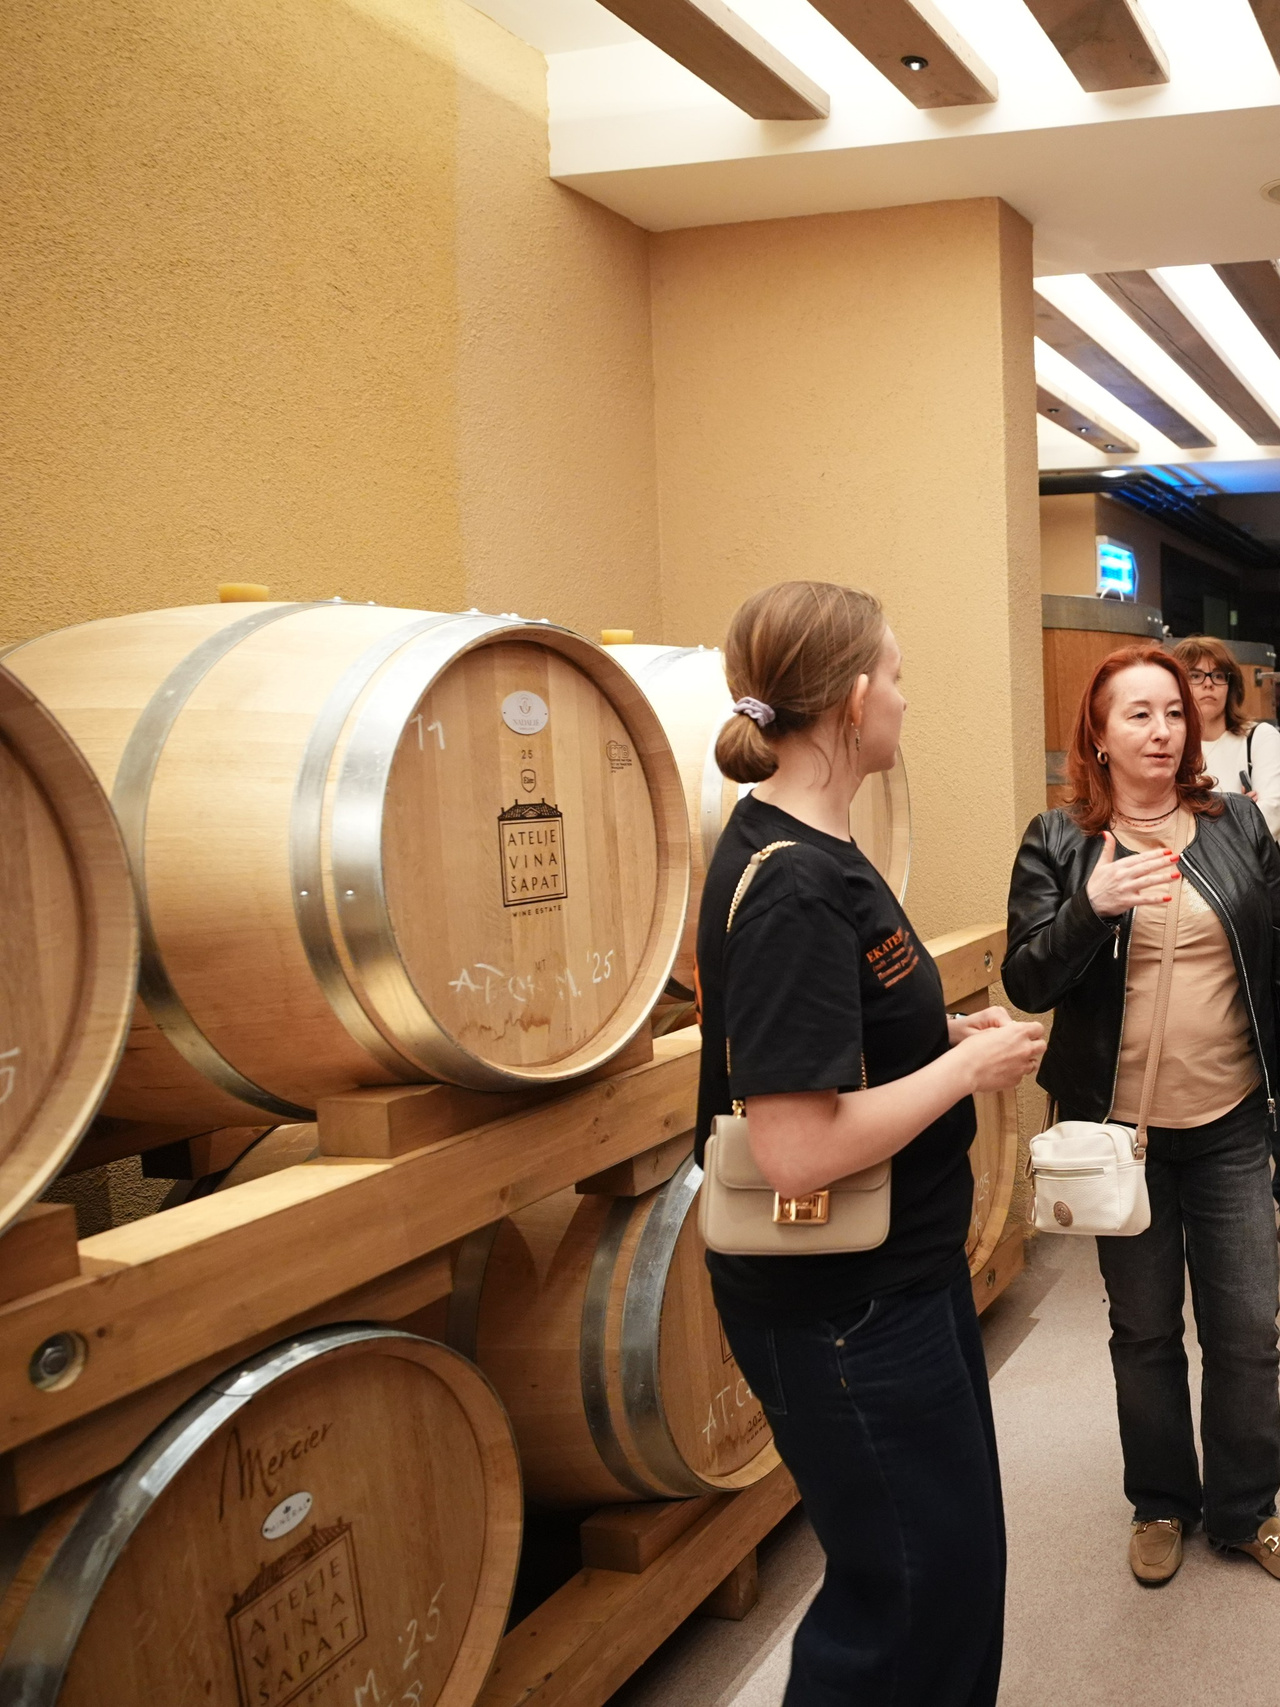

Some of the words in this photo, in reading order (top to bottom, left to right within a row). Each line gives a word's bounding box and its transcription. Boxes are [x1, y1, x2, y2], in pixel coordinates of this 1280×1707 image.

[521, 749, 534, 760] 25
[508, 829, 556, 846] ATELJE
[509, 853, 557, 869] VINA
[511, 874, 558, 894] ŠAPAT
[513, 909, 532, 918] WINE
[535, 904, 562, 915] ESTATE
[866, 926, 904, 963] EKATE
[746, 1410, 766, 1433] 202
[219, 1422, 334, 1523] Mercier
[249, 1556, 341, 1639] ATELJE
[253, 1591, 345, 1669] VINA
[259, 1617, 349, 1706] ŠAPAT
